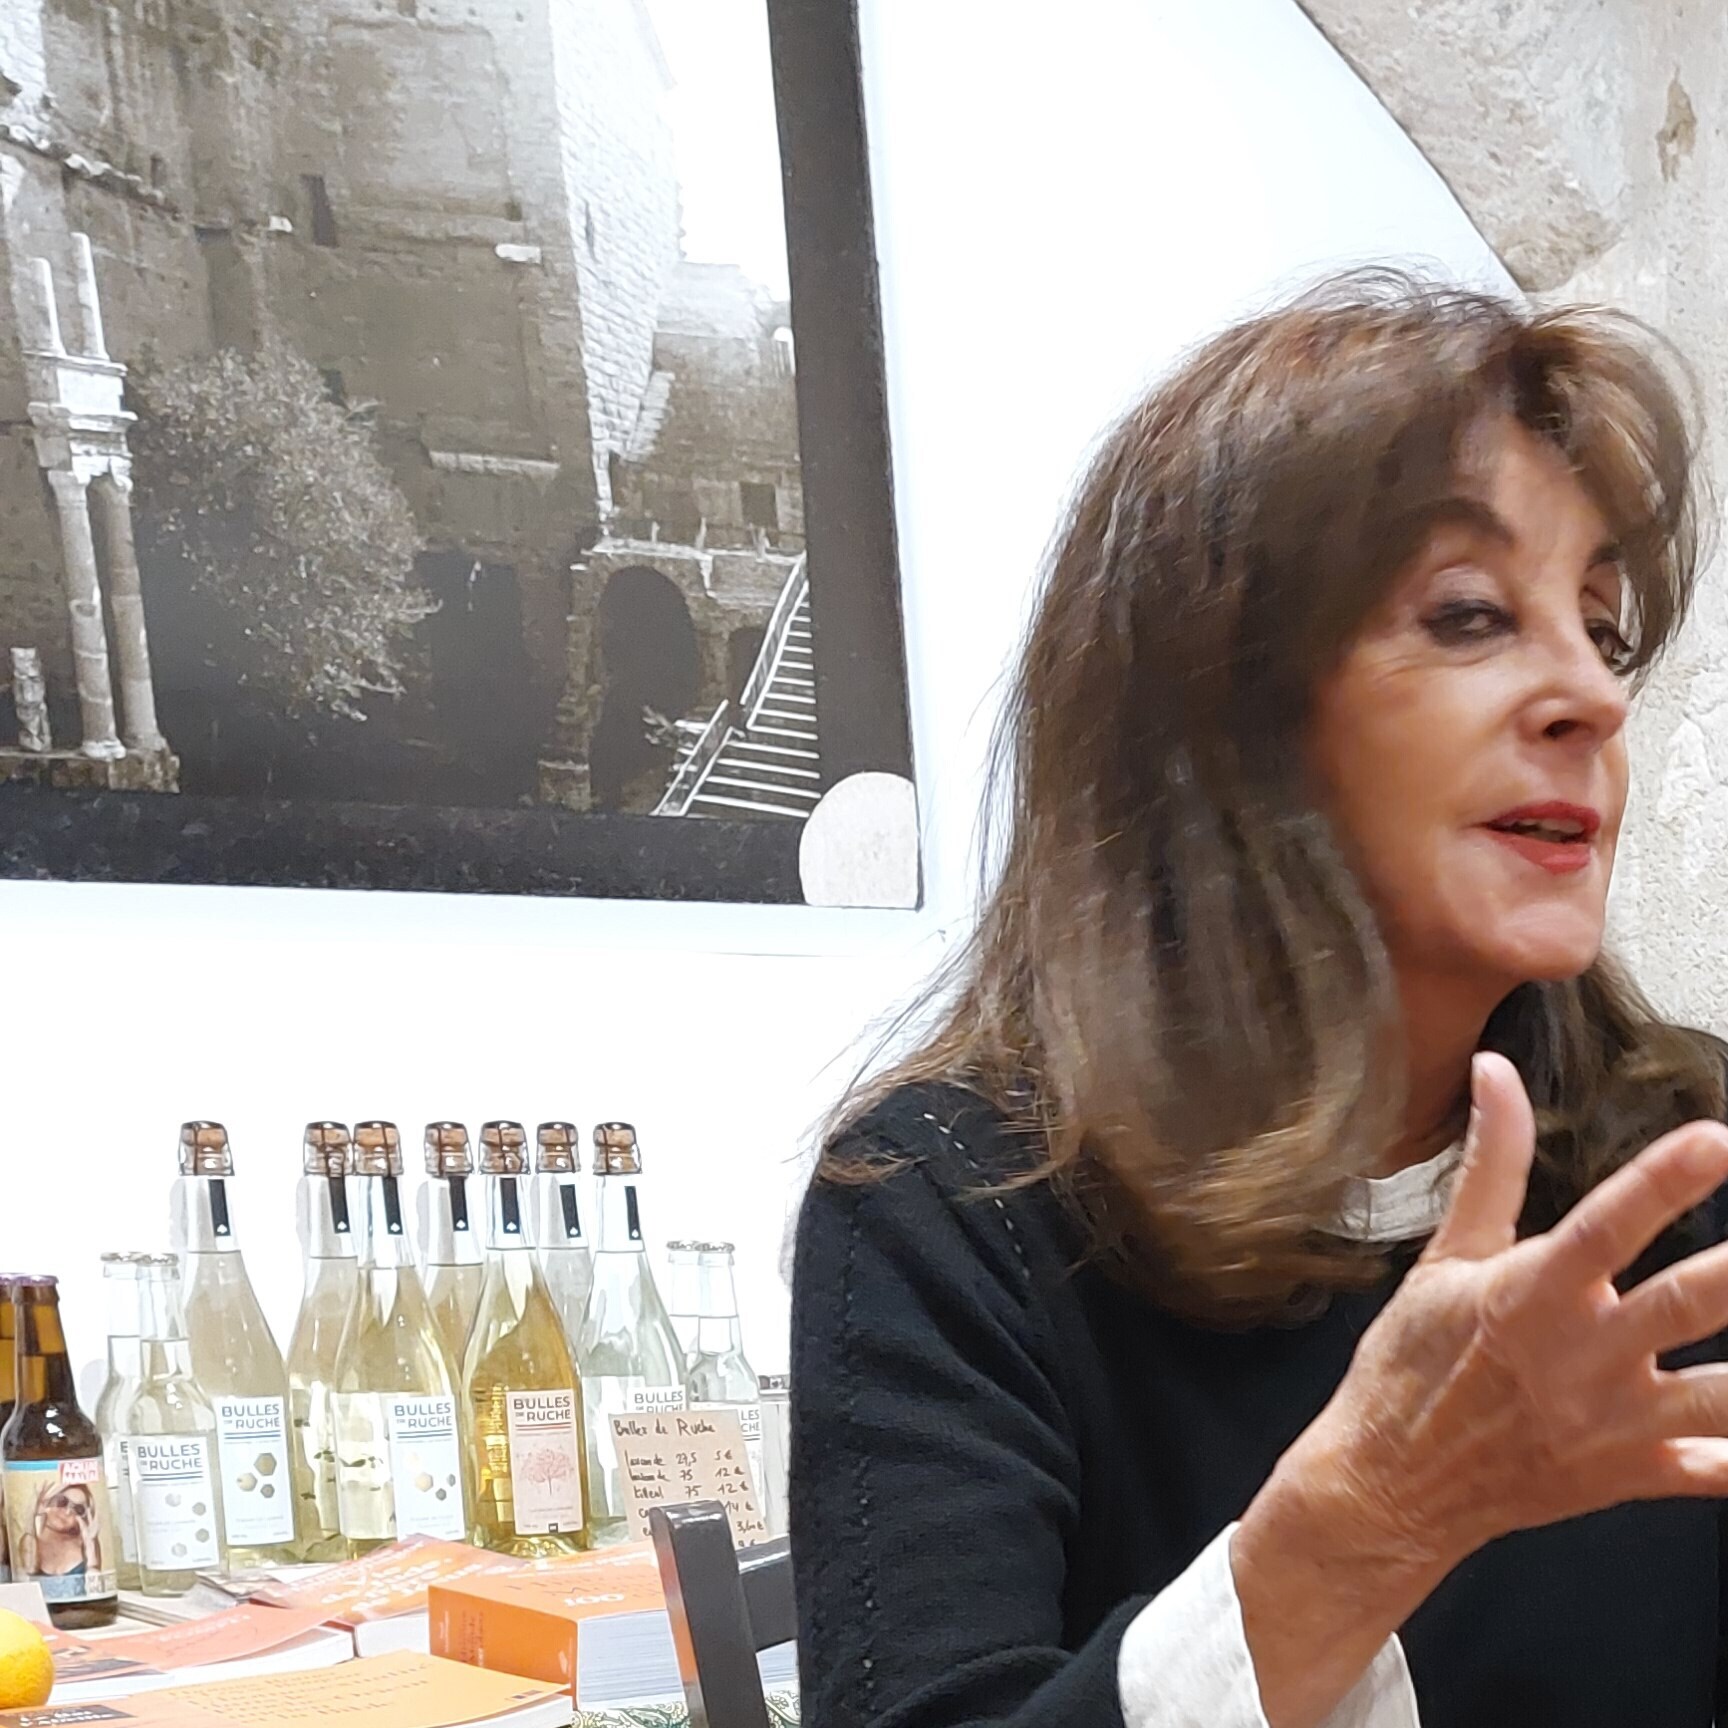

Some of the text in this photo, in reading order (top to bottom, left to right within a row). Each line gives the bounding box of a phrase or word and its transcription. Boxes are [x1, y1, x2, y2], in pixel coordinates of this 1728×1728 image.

[514, 1396, 571, 1410] BULLES
[634, 1391, 683, 1404] BULLES
[222, 1404, 280, 1417] BULLES
[394, 1402, 451, 1417] BULLES
[526, 1409, 571, 1421] RUCHE
[741, 1409, 760, 1421] LES
[235, 1417, 281, 1429] RUCHE
[408, 1416, 453, 1428] RUCHE
[741, 1421, 760, 1432] CHE
[138, 1444, 200, 1458] BULLES
[150, 1458, 203, 1471] RUCHE
